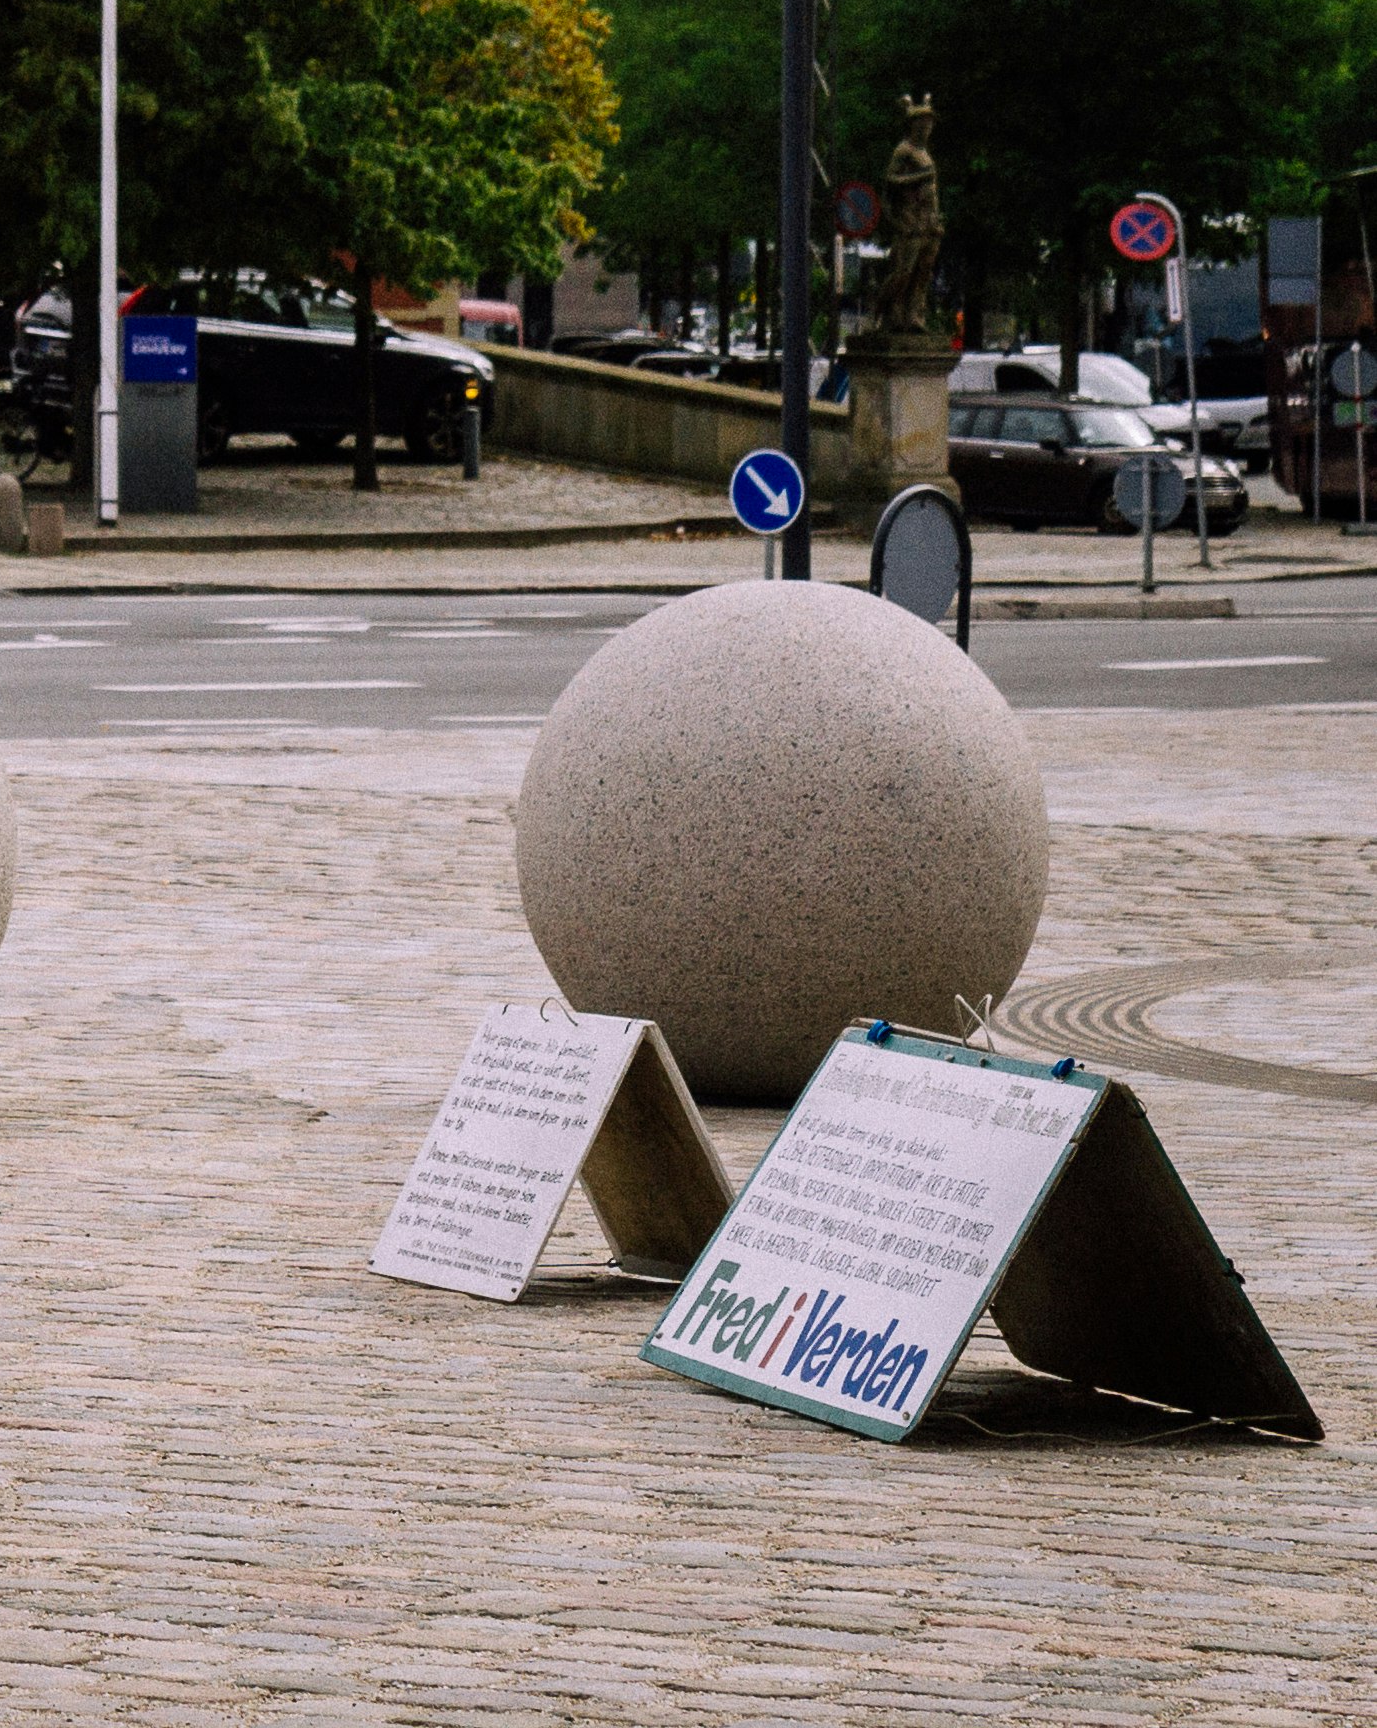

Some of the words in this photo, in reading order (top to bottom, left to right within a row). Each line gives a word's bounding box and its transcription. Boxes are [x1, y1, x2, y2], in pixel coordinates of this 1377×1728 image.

[672, 1259, 789, 1363] Fred
[759, 1291, 808, 1369] i
[781, 1289, 929, 1411] Verden
